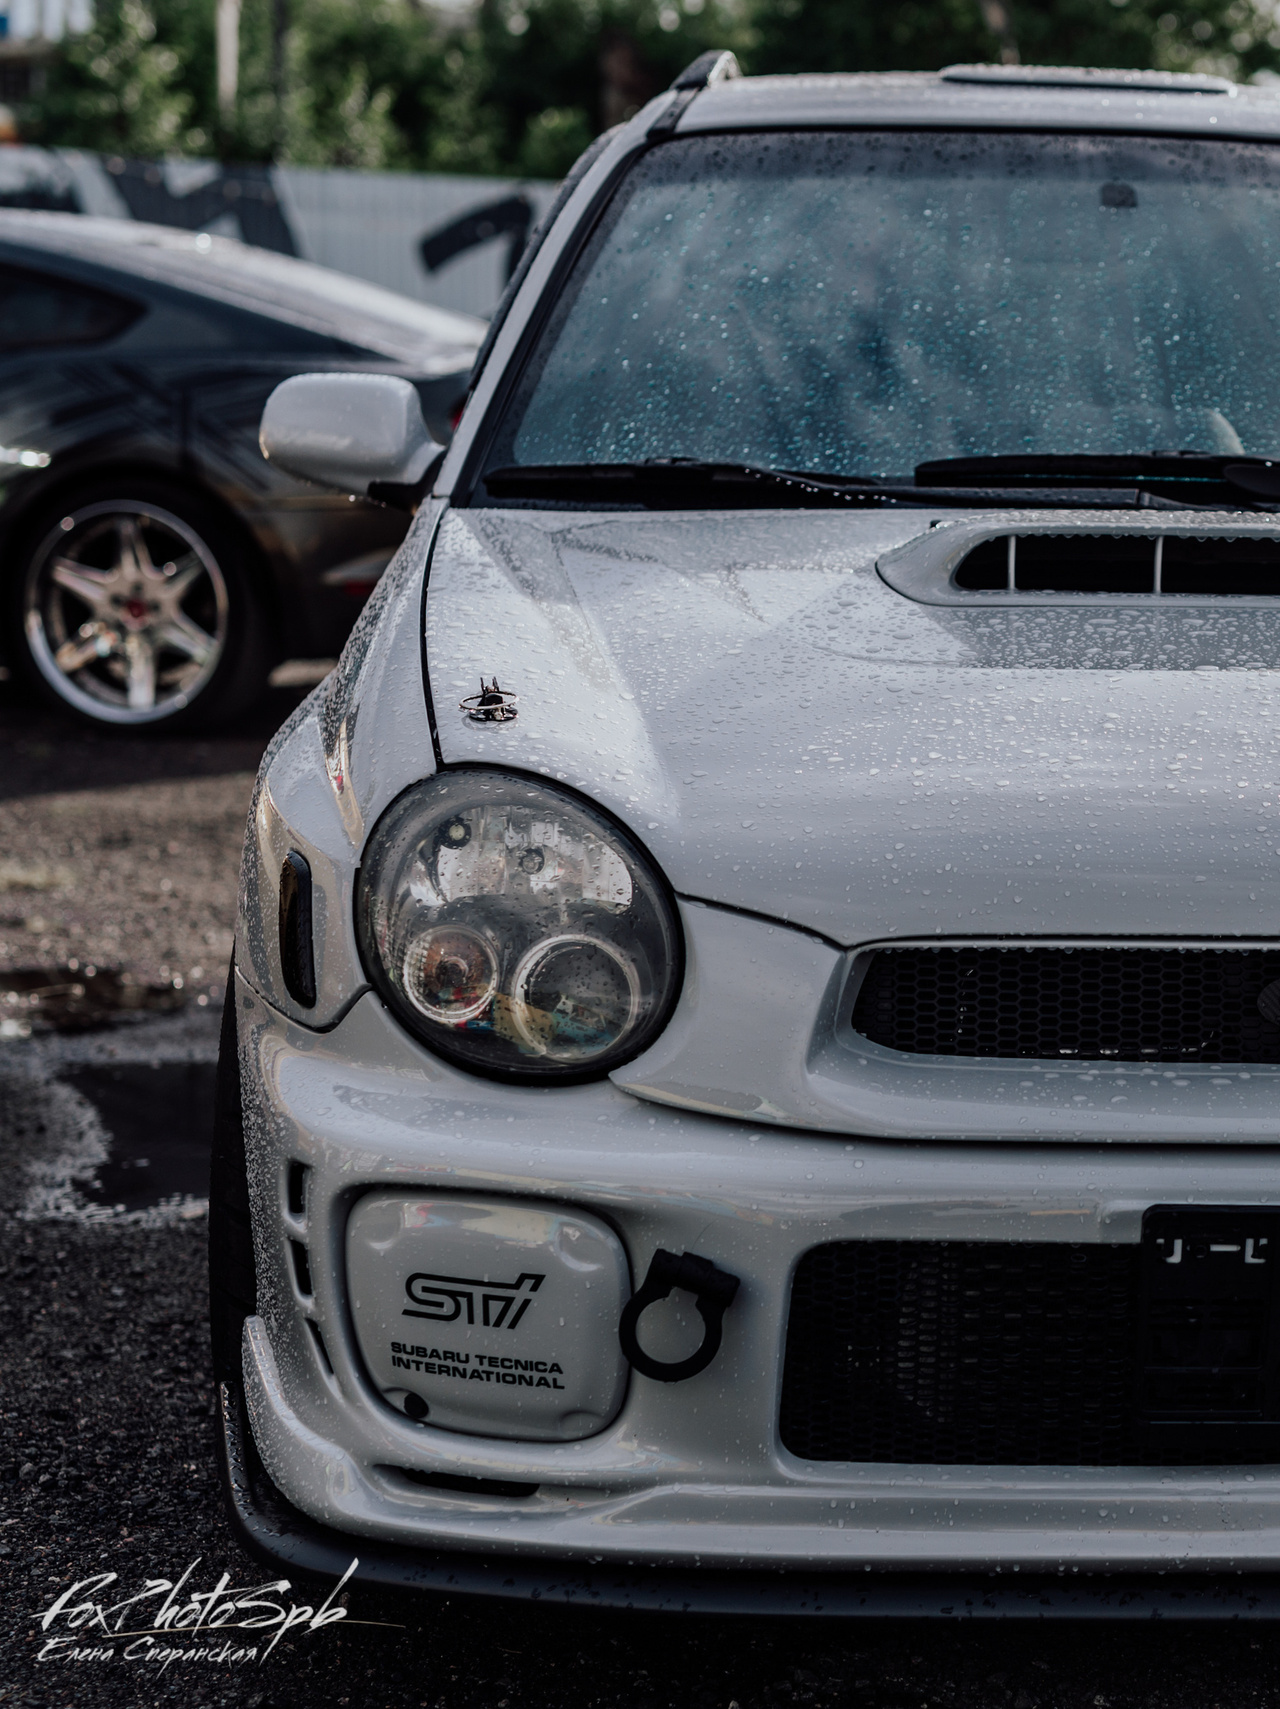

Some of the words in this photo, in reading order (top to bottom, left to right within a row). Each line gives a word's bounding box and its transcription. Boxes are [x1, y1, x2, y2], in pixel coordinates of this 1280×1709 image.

[390, 1341, 470, 1364] SUBARU
[474, 1353, 564, 1375] TECNICA
[391, 1355, 566, 1390] INTERNATIONAL
